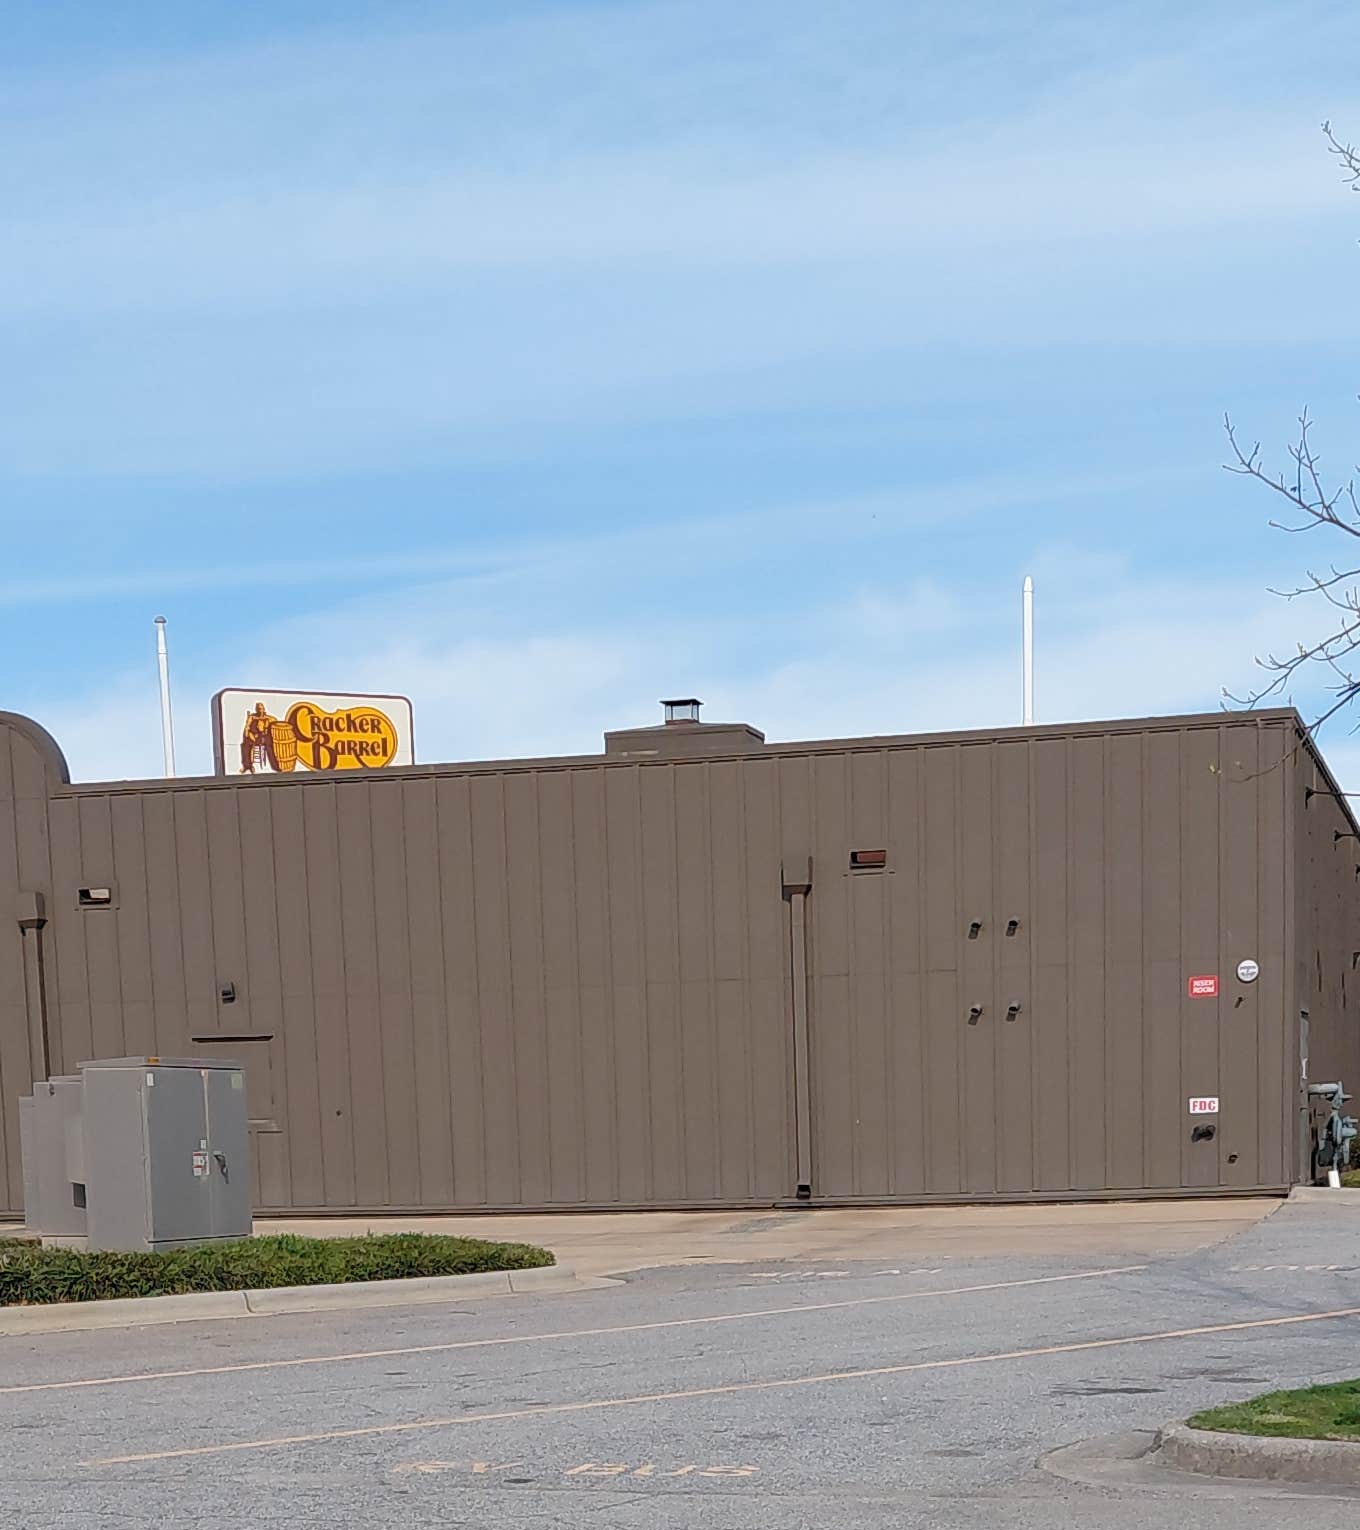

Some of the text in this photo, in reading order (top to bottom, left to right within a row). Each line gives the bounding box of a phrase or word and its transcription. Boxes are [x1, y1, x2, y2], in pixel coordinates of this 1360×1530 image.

[288, 705, 382, 743] Cracker
[312, 731, 388, 769] Barrel
[1192, 1099, 1216, 1111] FDC
